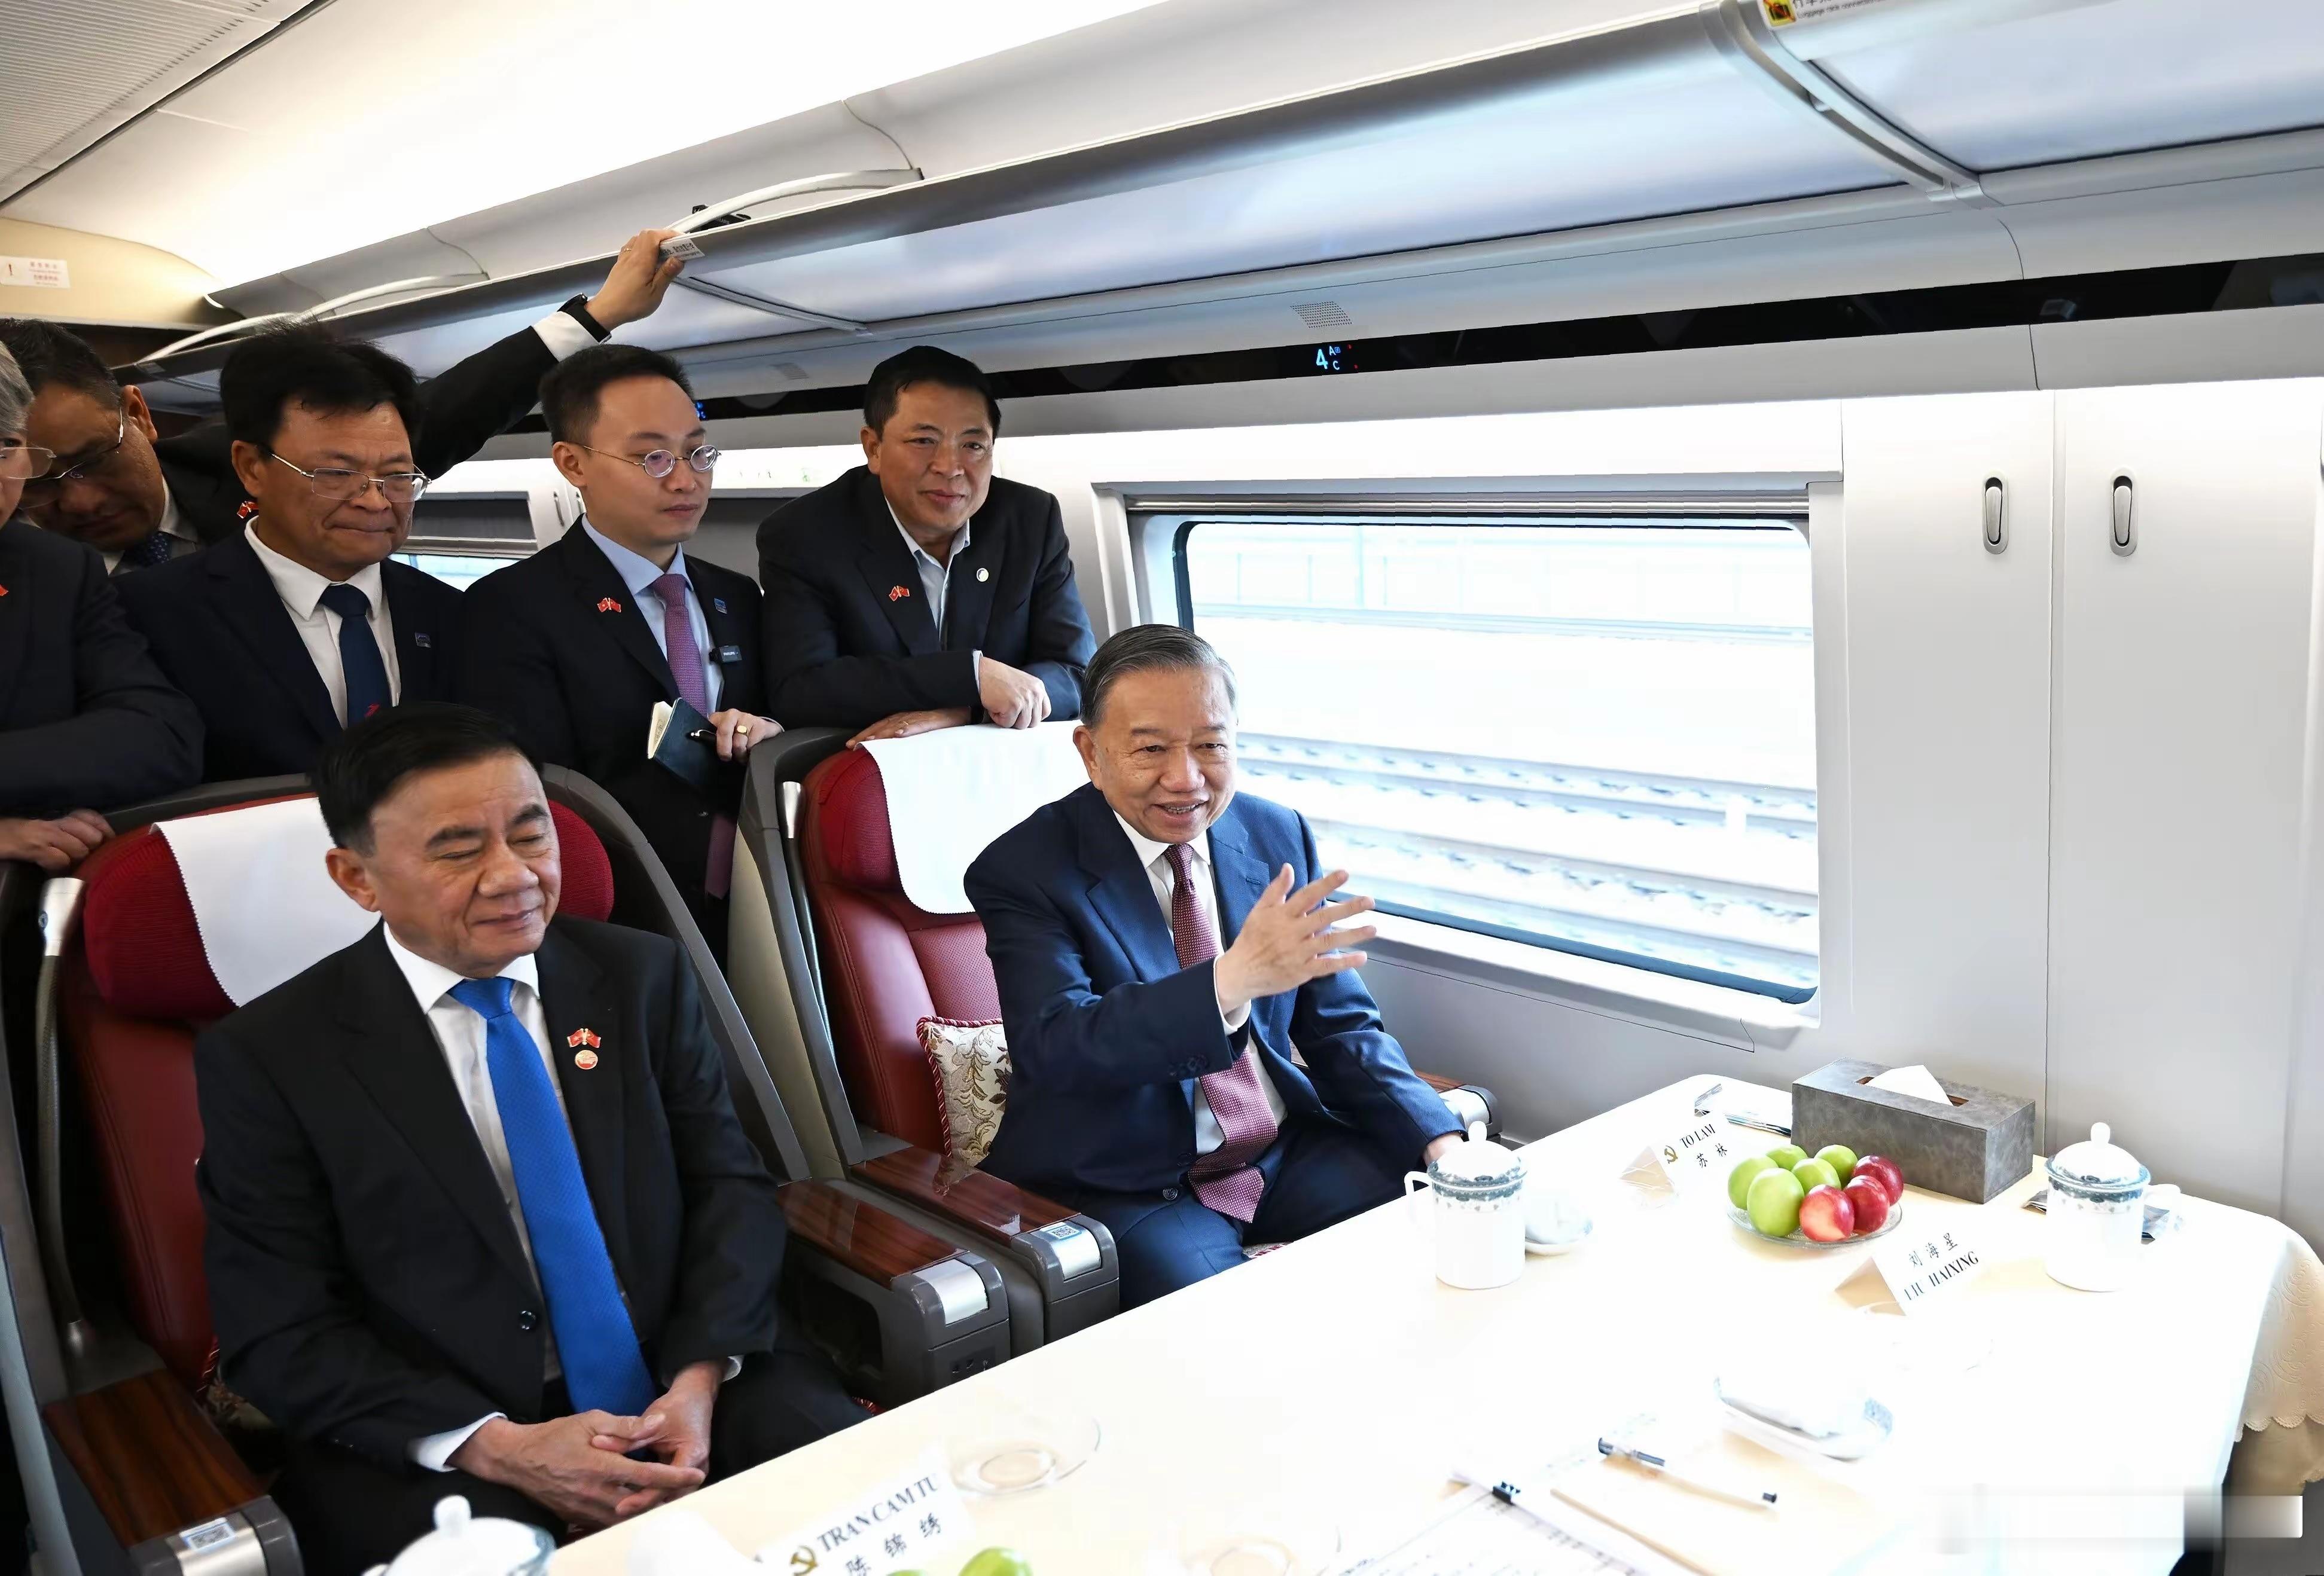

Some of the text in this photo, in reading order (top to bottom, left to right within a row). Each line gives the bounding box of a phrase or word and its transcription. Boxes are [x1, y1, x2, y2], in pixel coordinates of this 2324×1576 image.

[1316, 349, 1328, 369] 4
[1329, 346, 1336, 356] A
[1332, 361, 1340, 370] C
[1679, 1123, 1716, 1148] TO LAM
[1929, 1251, 1978, 1287] HAIXING
[817, 1474, 940, 1551] TRAN CAM TU
